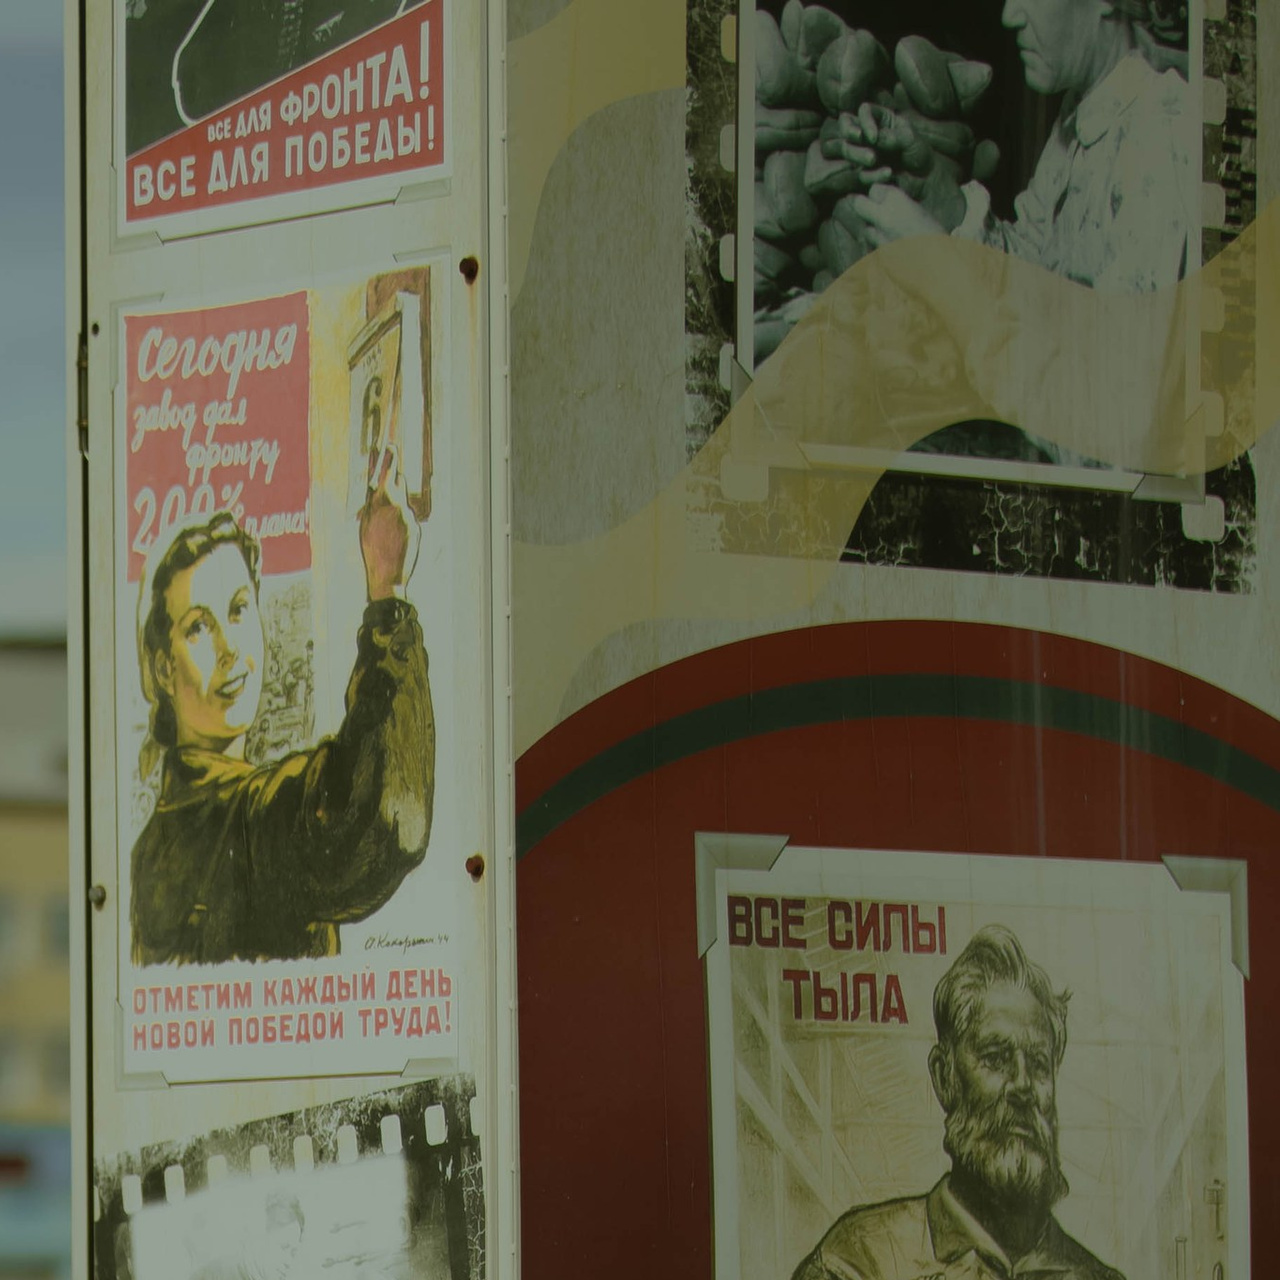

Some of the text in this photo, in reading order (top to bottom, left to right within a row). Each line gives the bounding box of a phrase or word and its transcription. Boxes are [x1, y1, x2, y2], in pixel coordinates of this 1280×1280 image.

[208, 21, 429, 142] ВСЕ ДЛЯ ФРОНТА!
[134, 105, 434, 206] ВСЕ ДЛЯ ПОБЕДЫ!
[138, 323, 297, 399] Сегодня
[727, 895, 947, 955] ВСЕ СИЛЫ
[133, 967, 452, 1015] ОТМЕТИМ КАЖДЫЙ ДЕНЬ
[783, 968, 909, 1024] ТЫЛА
[133, 1001, 452, 1051] НОВОЙ ПОБЕДОЙ ТРУДА!
